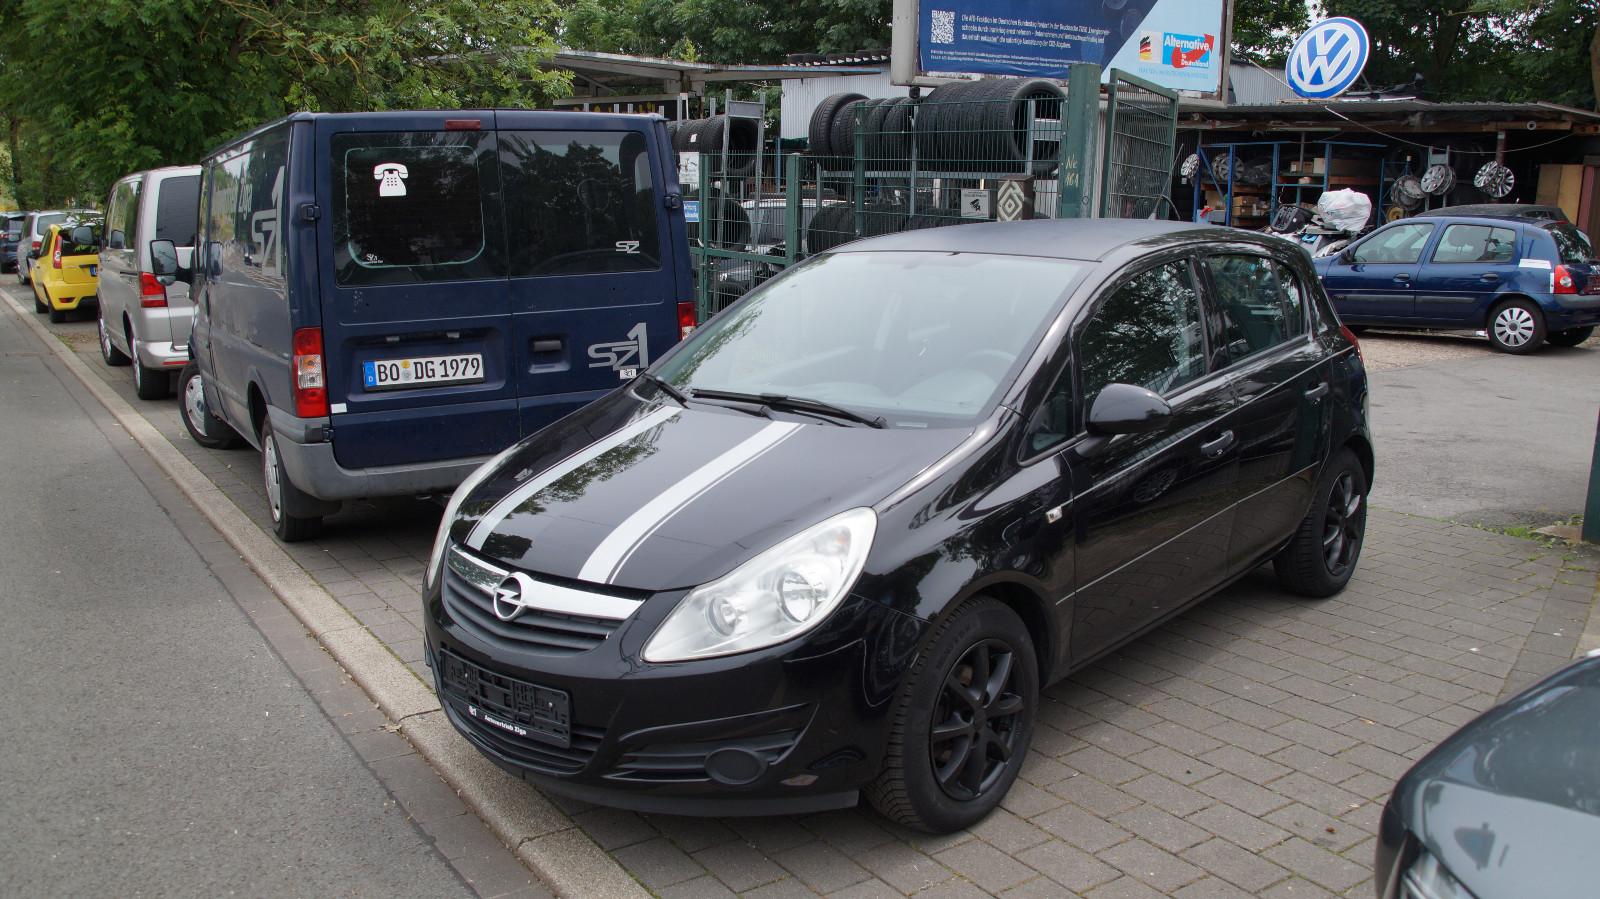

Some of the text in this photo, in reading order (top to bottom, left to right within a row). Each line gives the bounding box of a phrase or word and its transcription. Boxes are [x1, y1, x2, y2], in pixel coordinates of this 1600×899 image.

[1164, 34, 1210, 51] Alternative
[1180, 58, 1209, 68] Deutschland
[377, 357, 480, 382] BO DG 1979
